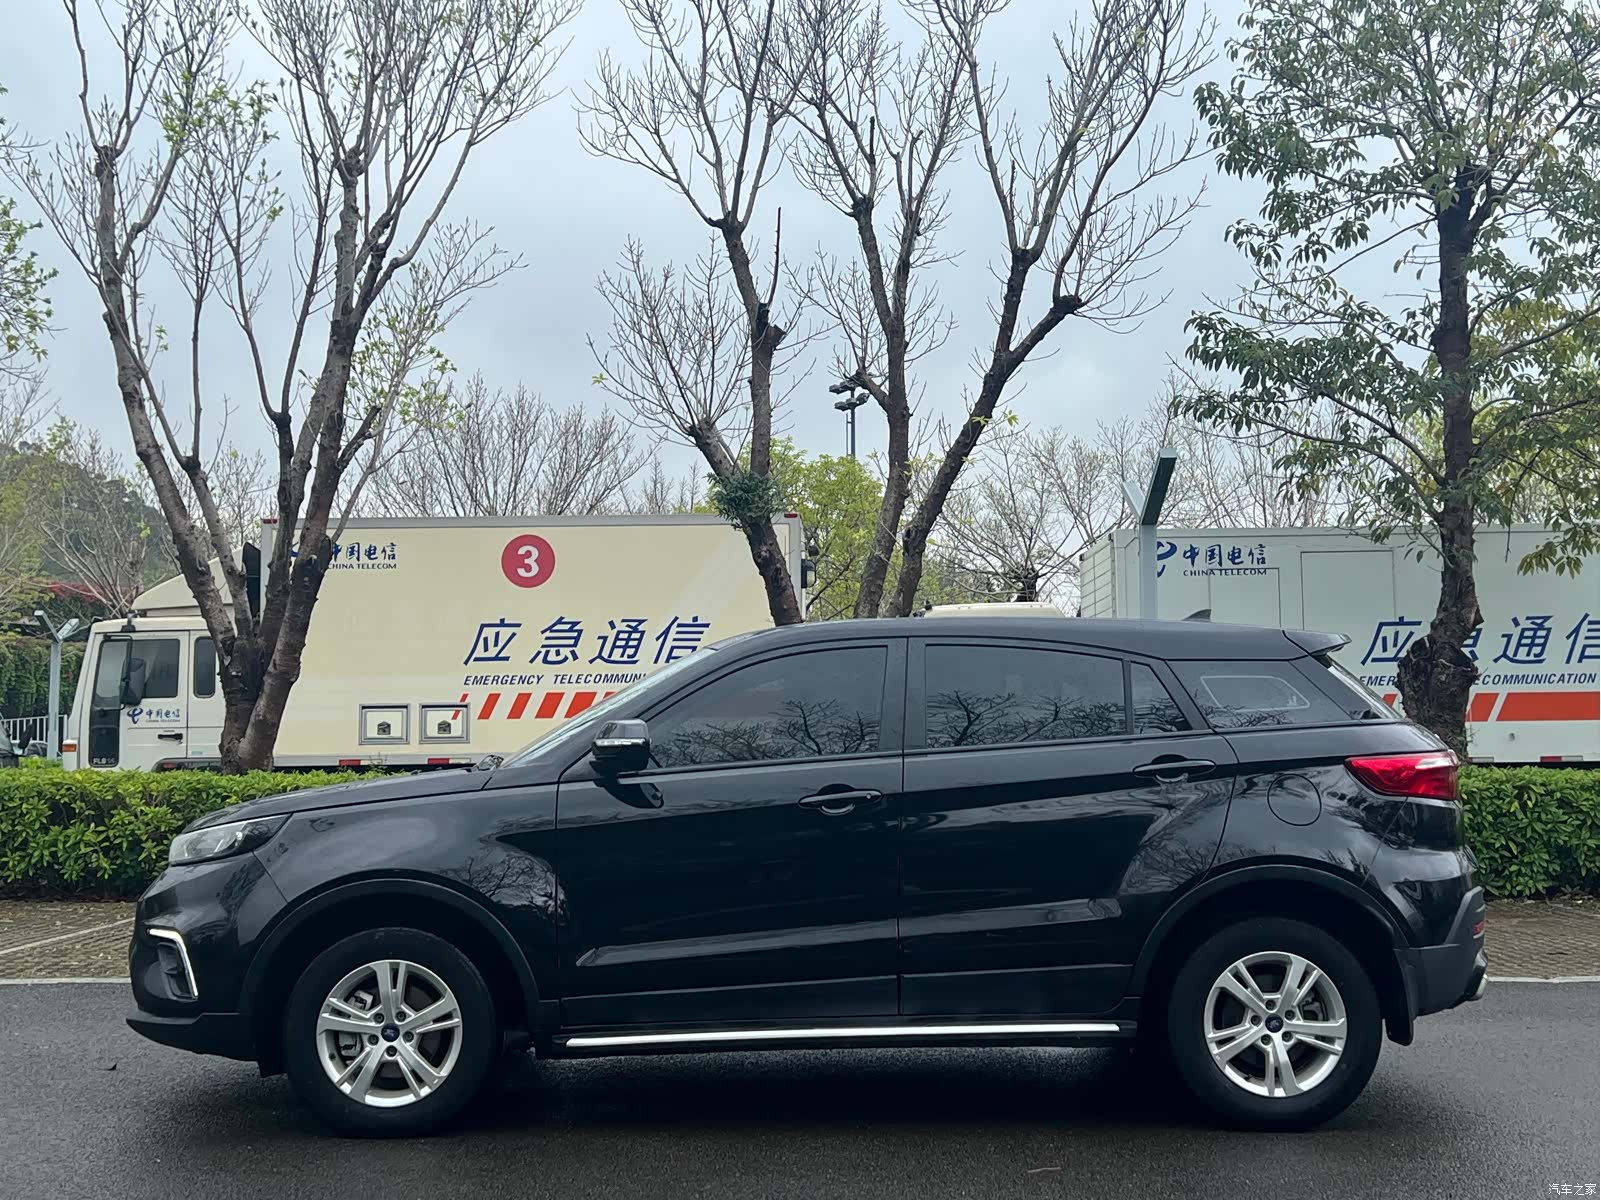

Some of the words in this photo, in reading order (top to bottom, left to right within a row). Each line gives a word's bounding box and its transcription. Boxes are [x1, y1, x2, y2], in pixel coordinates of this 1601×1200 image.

[516, 545, 540, 578] 3
[1182, 543, 1267, 567] 中国电信
[1183, 569, 1216, 577] CHINA
[1219, 568, 1268, 576] TELECOM
[463, 615, 712, 667] 应急通信
[1360, 612, 1600, 666] 应通信
[463, 674, 545, 686] EMERGENCY
[1472, 672, 1598, 686] COMMUNICATION
